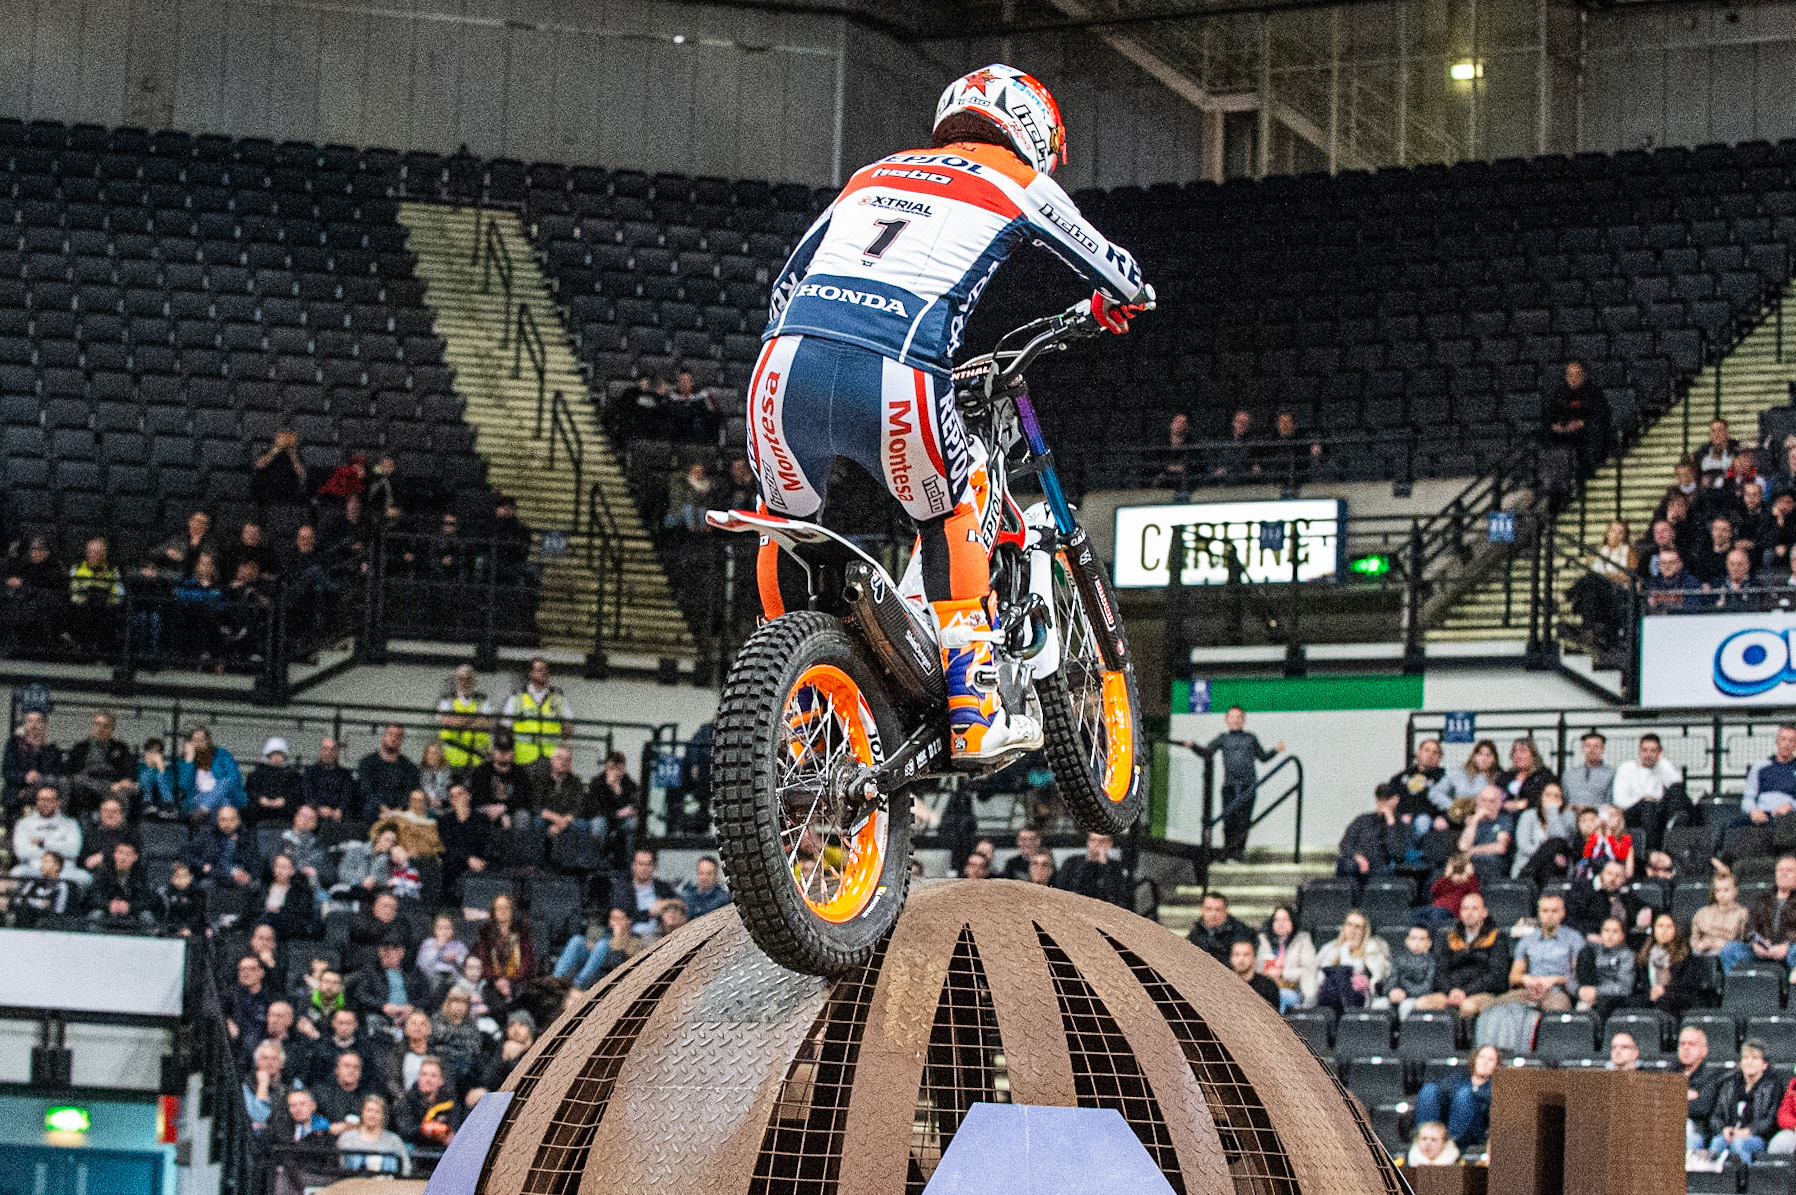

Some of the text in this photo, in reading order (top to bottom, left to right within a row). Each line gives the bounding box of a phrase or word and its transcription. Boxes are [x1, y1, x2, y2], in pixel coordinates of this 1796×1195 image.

[871, 167, 955, 185] hebo
[884, 155, 983, 175] EPSOL
[863, 217, 911, 259] 1
[1038, 203, 1099, 254] hebo
[796, 284, 908, 318] HONDA
[761, 370, 804, 493] Montesa
[889, 400, 914, 502] Montesa
[940, 387, 968, 495] REPSOL
[922, 474, 945, 514] hebo
